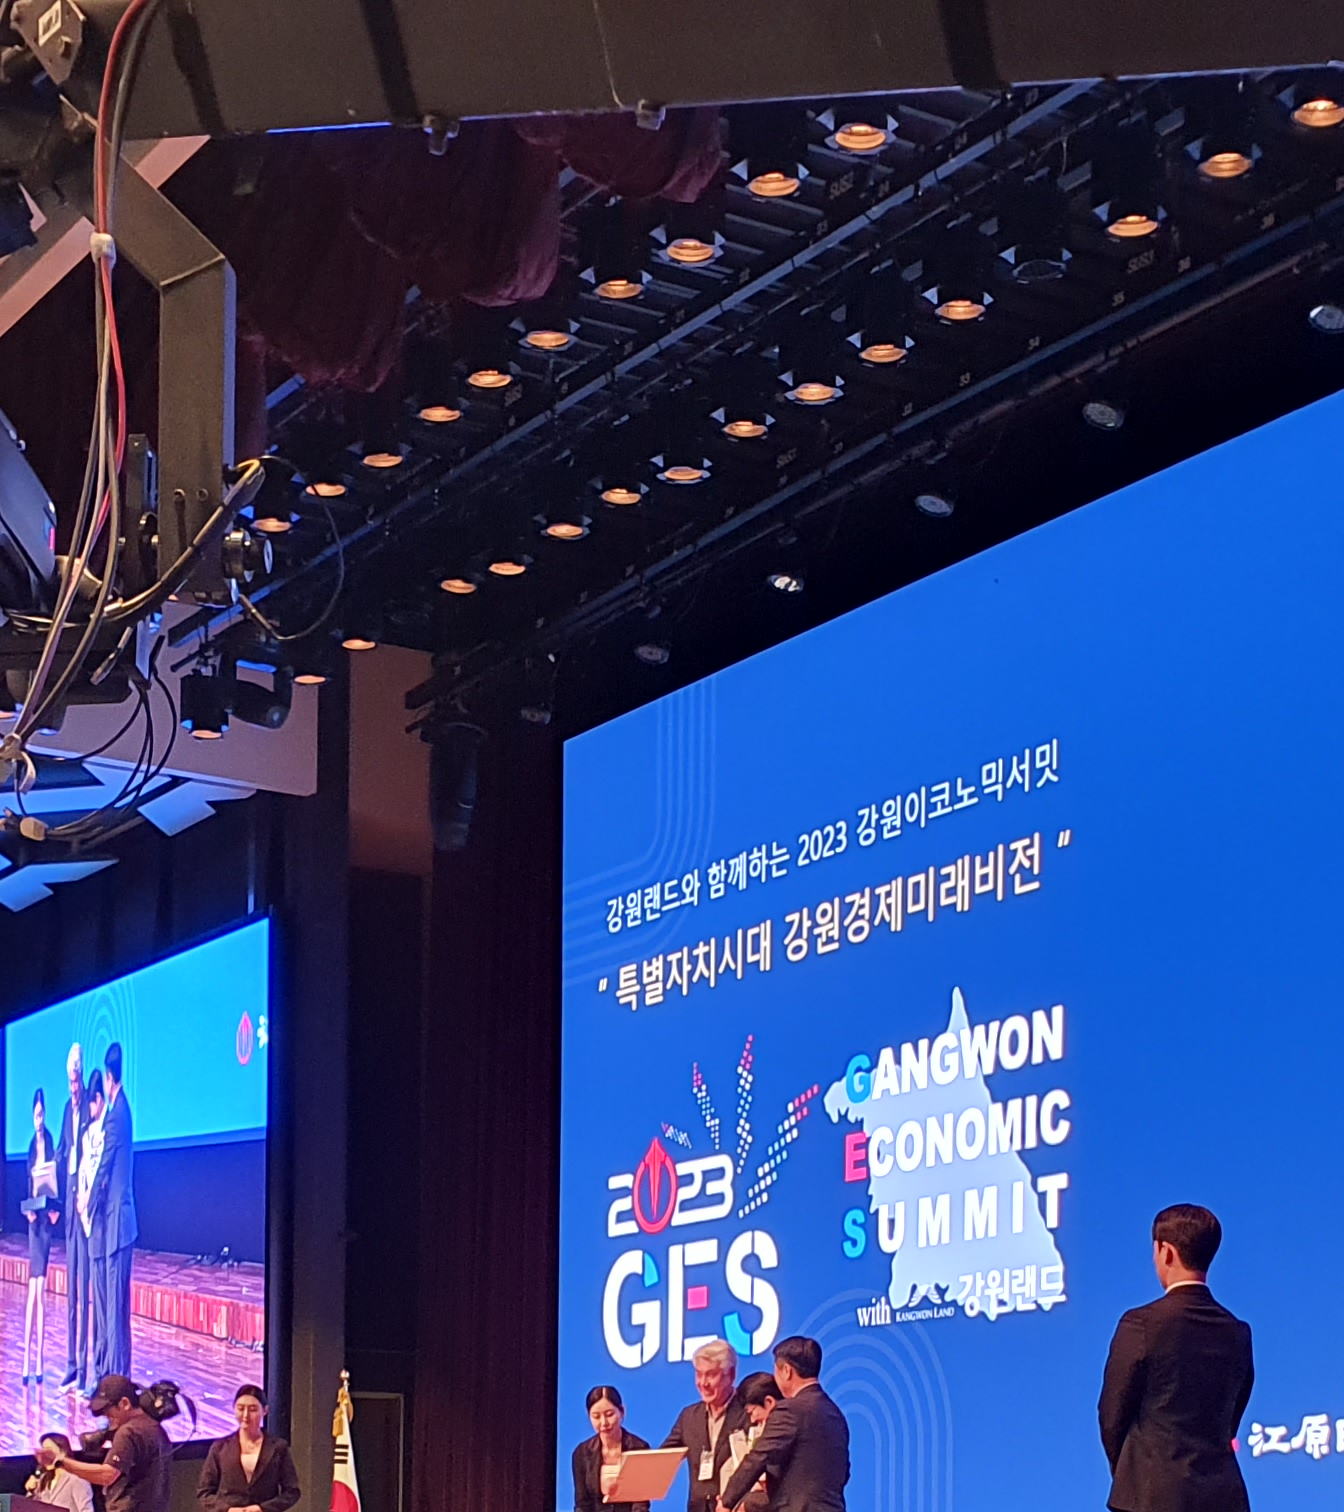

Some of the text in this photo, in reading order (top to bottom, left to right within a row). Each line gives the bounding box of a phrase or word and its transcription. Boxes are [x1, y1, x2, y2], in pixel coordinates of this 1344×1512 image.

[606, 738, 1059, 933] 강원랜드와 함께하는 2023 강원이코노믹서밋
[615, 920, 772, 1011] 특별자치시대
[783, 832, 1041, 962] 강원경제미래비전
[846, 1004, 1064, 1104] GANGWON
[844, 1089, 1071, 1182] ECONOMIC
[843, 1173, 1068, 1259] SUMMIT
[602, 1229, 780, 1369] GES
[856, 1264, 1067, 1327] with KANGWON LAND 강원랜드
